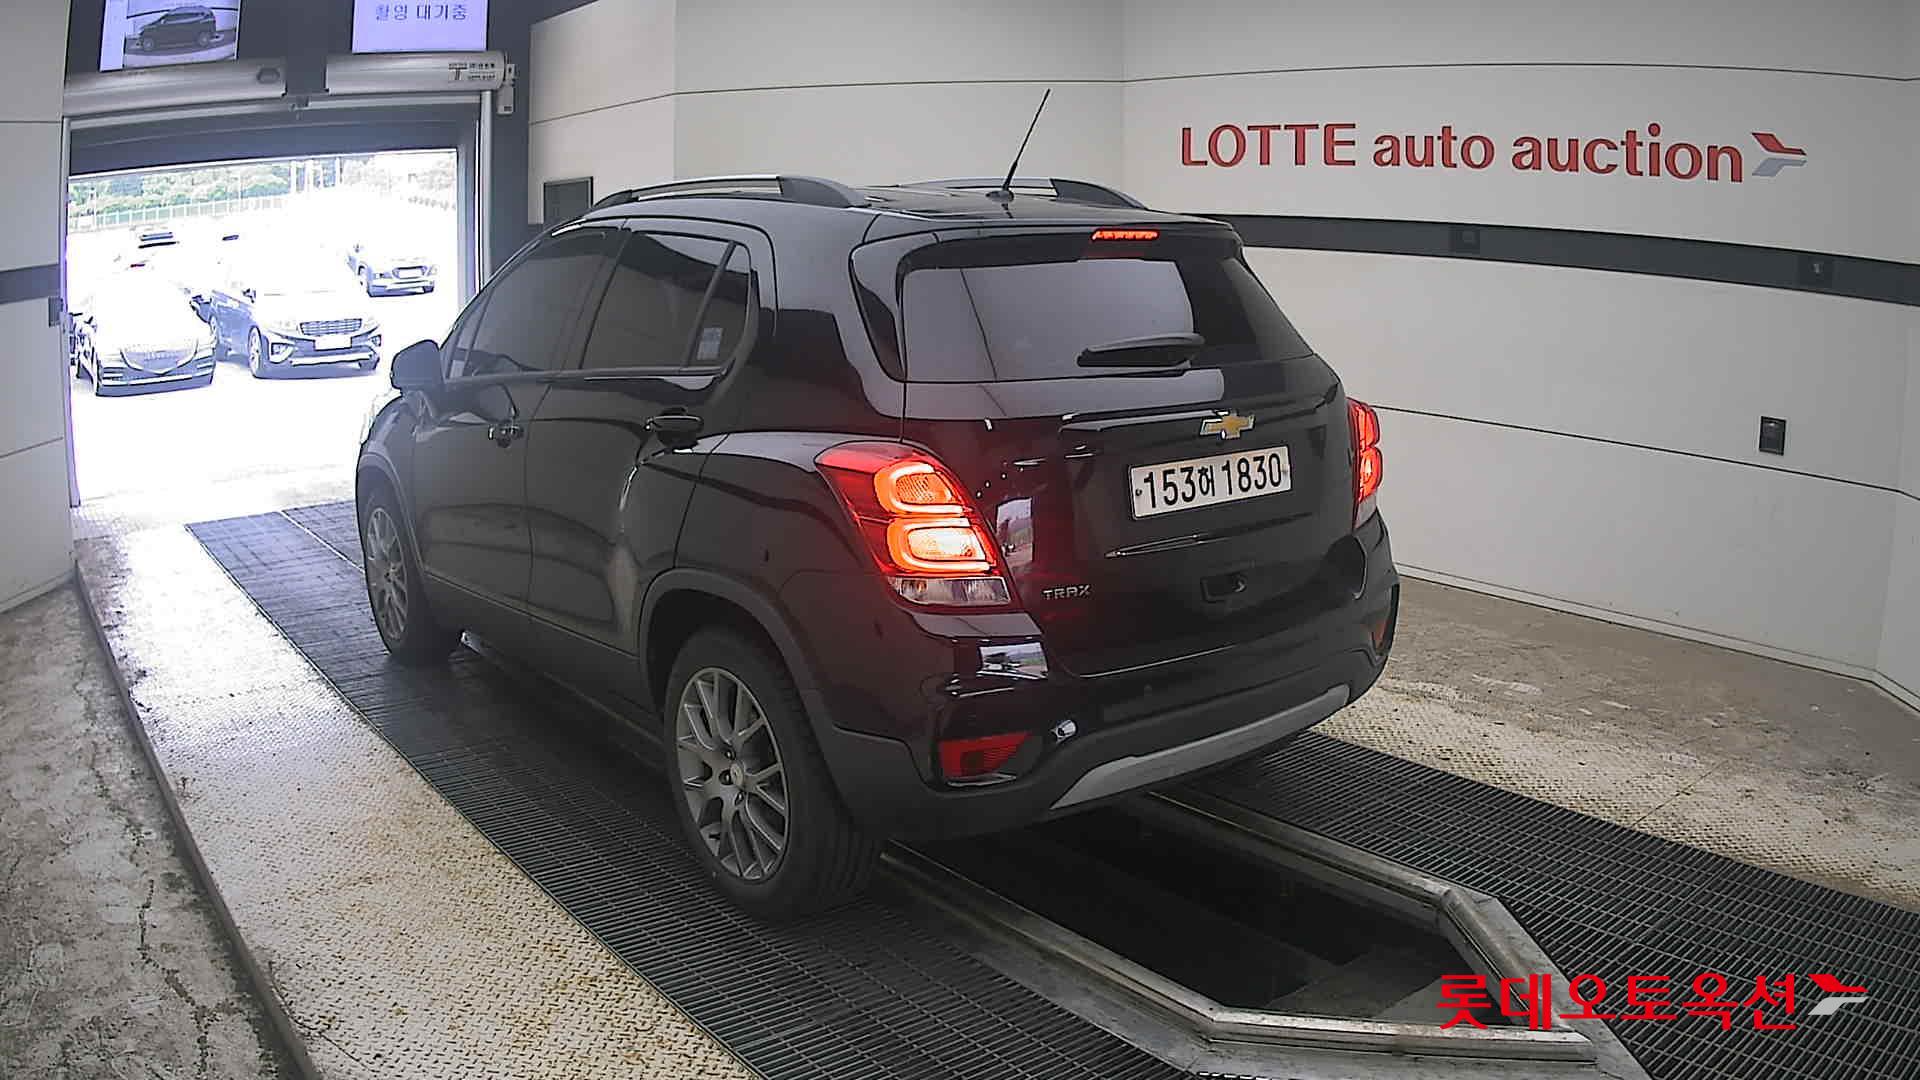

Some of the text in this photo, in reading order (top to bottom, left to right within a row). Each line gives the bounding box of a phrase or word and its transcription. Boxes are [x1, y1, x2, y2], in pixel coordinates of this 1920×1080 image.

[416, 4, 467, 21] 대기중
[1181, 122, 1744, 184] LOTTE auto auction
[1144, 453, 1282, 509] 153허 1830
[1042, 584, 1091, 601] TRAX
